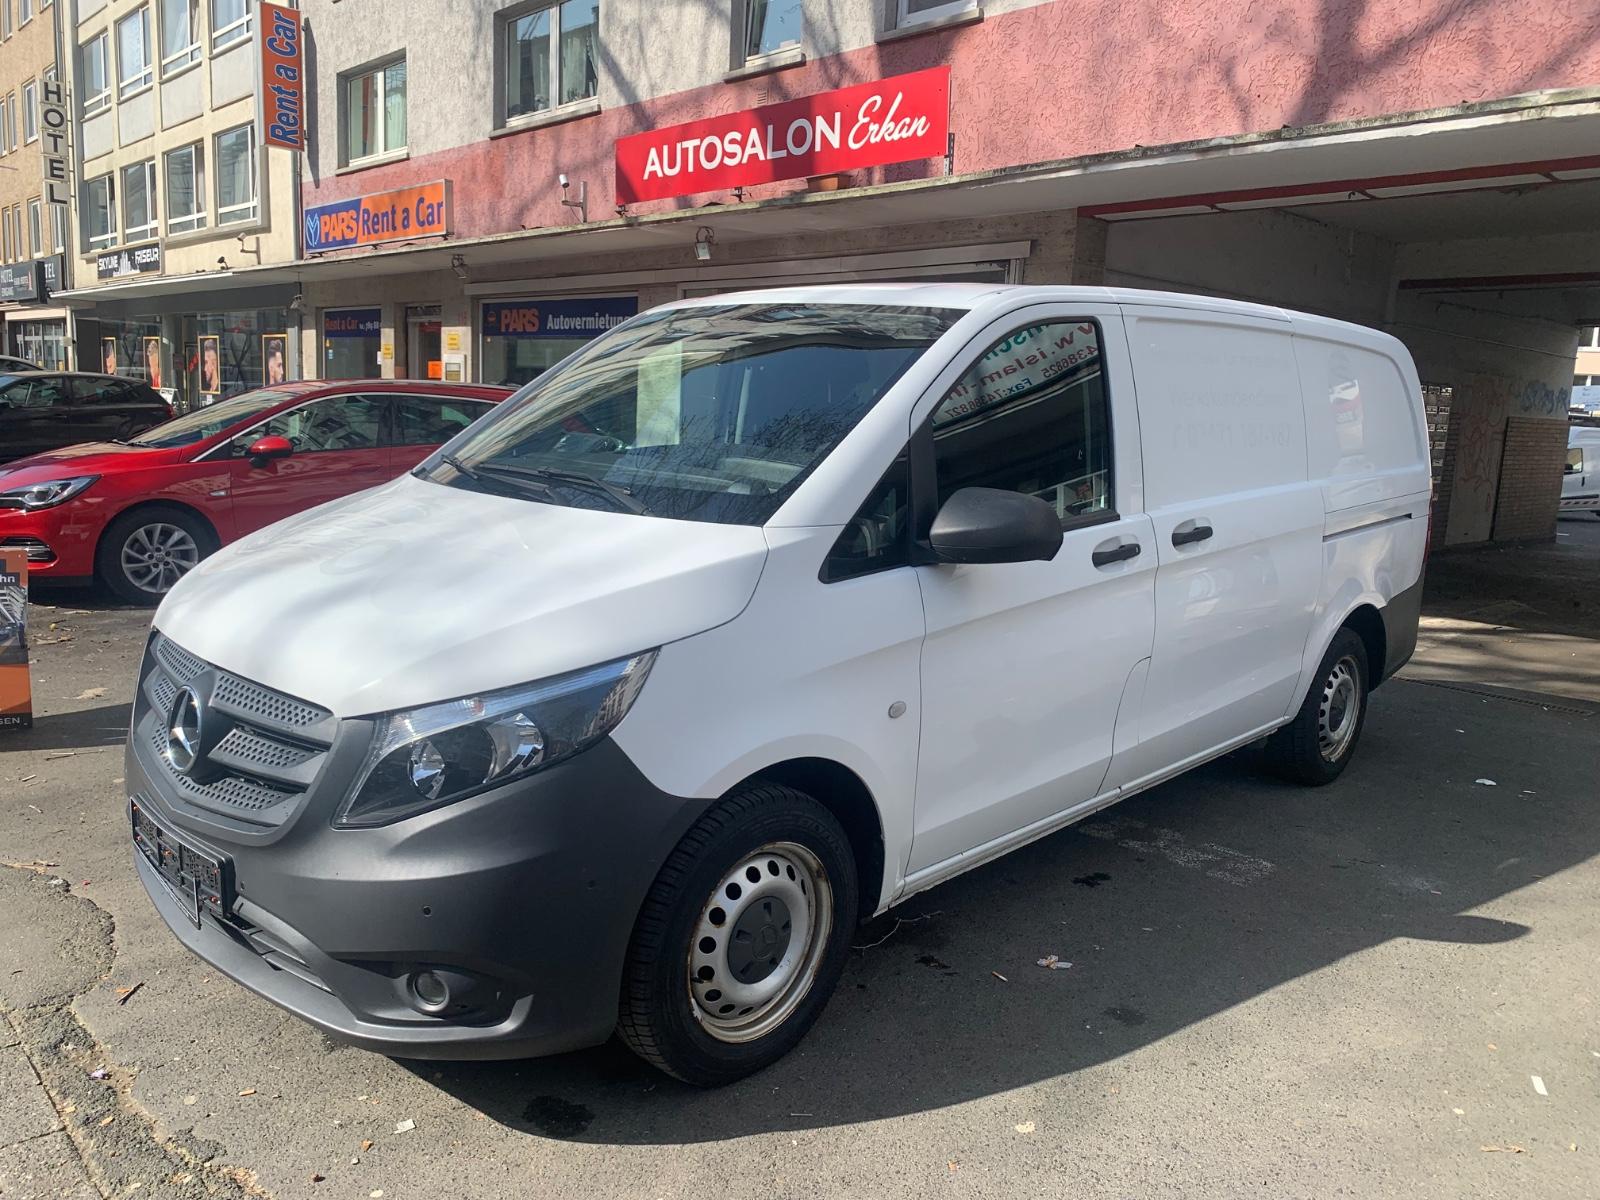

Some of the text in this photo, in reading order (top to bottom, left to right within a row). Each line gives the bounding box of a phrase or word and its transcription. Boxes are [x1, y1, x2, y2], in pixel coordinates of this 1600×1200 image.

[266, 9, 299, 145] Rent a Car
[43, 81, 68, 204] HOTEL
[643, 92, 930, 180] AUTOSALON Erkan
[320, 196, 444, 243] PARS Rent a Car
[135, 247, 159, 264] FRISEUR
[500, 308, 540, 332] PARS
